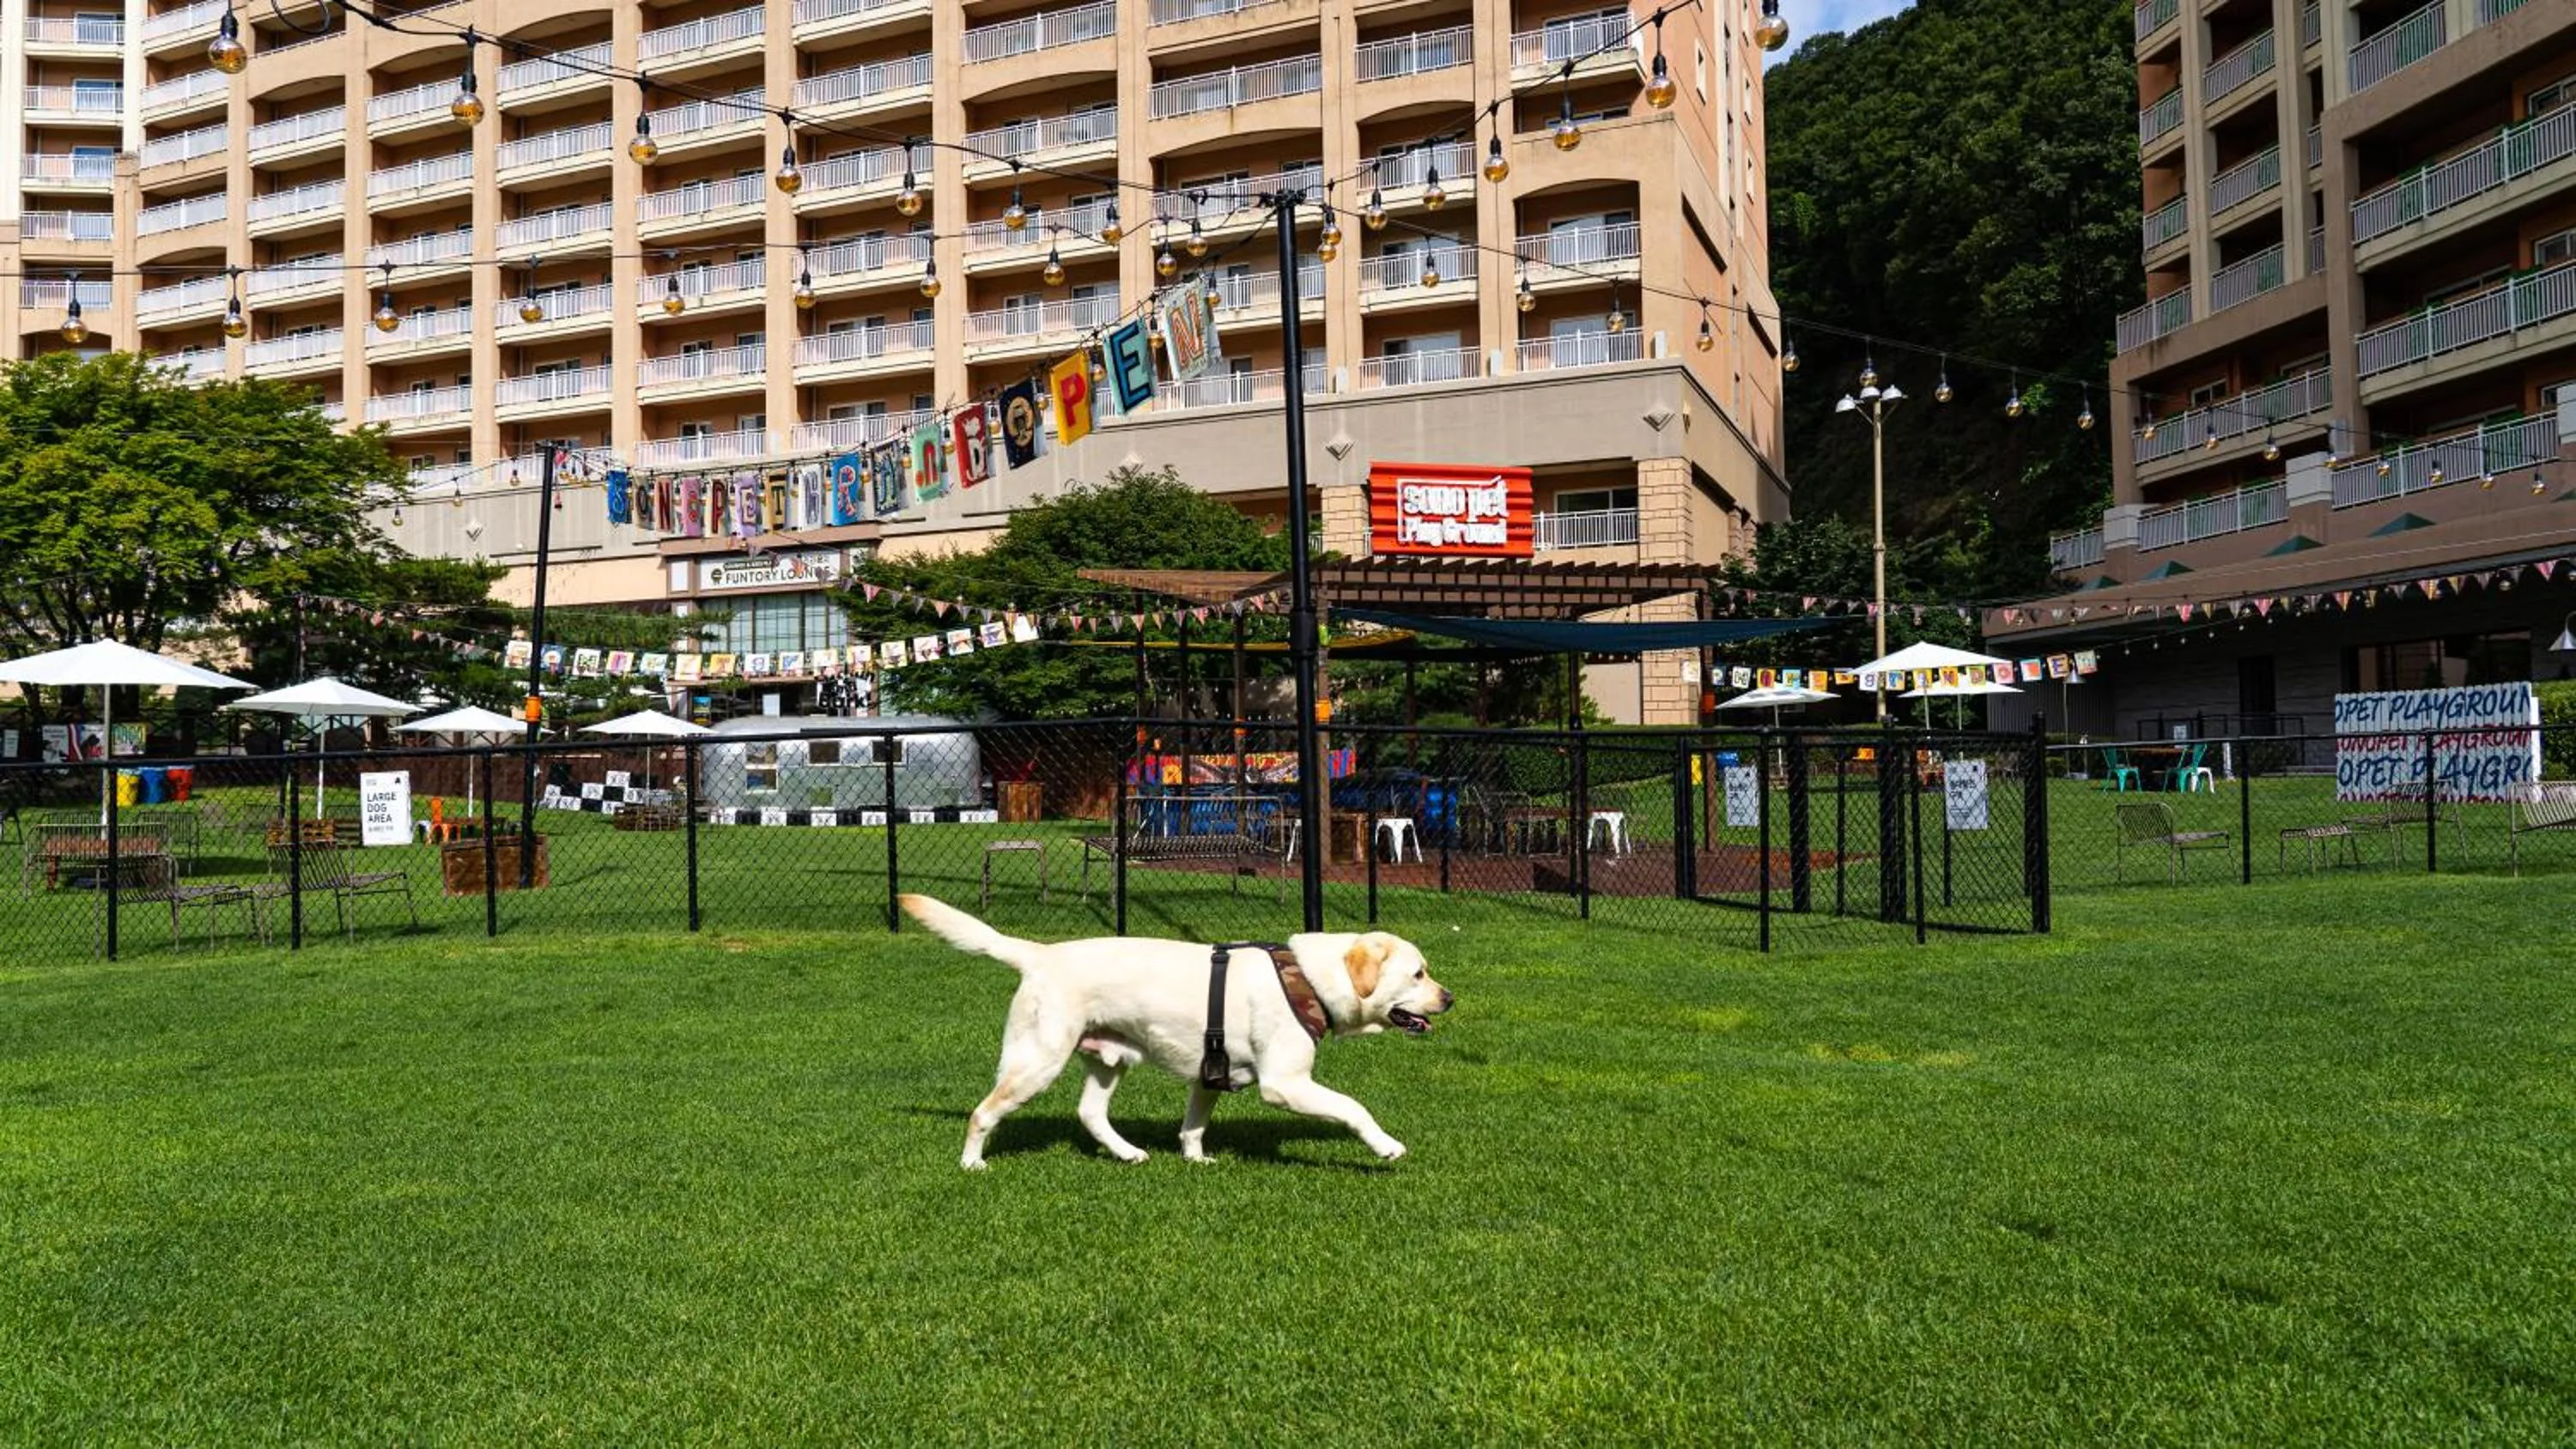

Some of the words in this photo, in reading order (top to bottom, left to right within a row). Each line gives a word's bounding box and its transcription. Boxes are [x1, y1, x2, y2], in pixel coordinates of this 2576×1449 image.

[1468, 478, 1509, 522] pet
[726, 569, 777, 585] FUNTORY
[781, 565, 829, 582] LOUNE
[2339, 756, 2404, 787] OPET
[2412, 755, 2533, 797] PAYGR
[367, 791, 397, 803] LARGE
[367, 803, 387, 813] DOG
[368, 813, 392, 823] AREA
